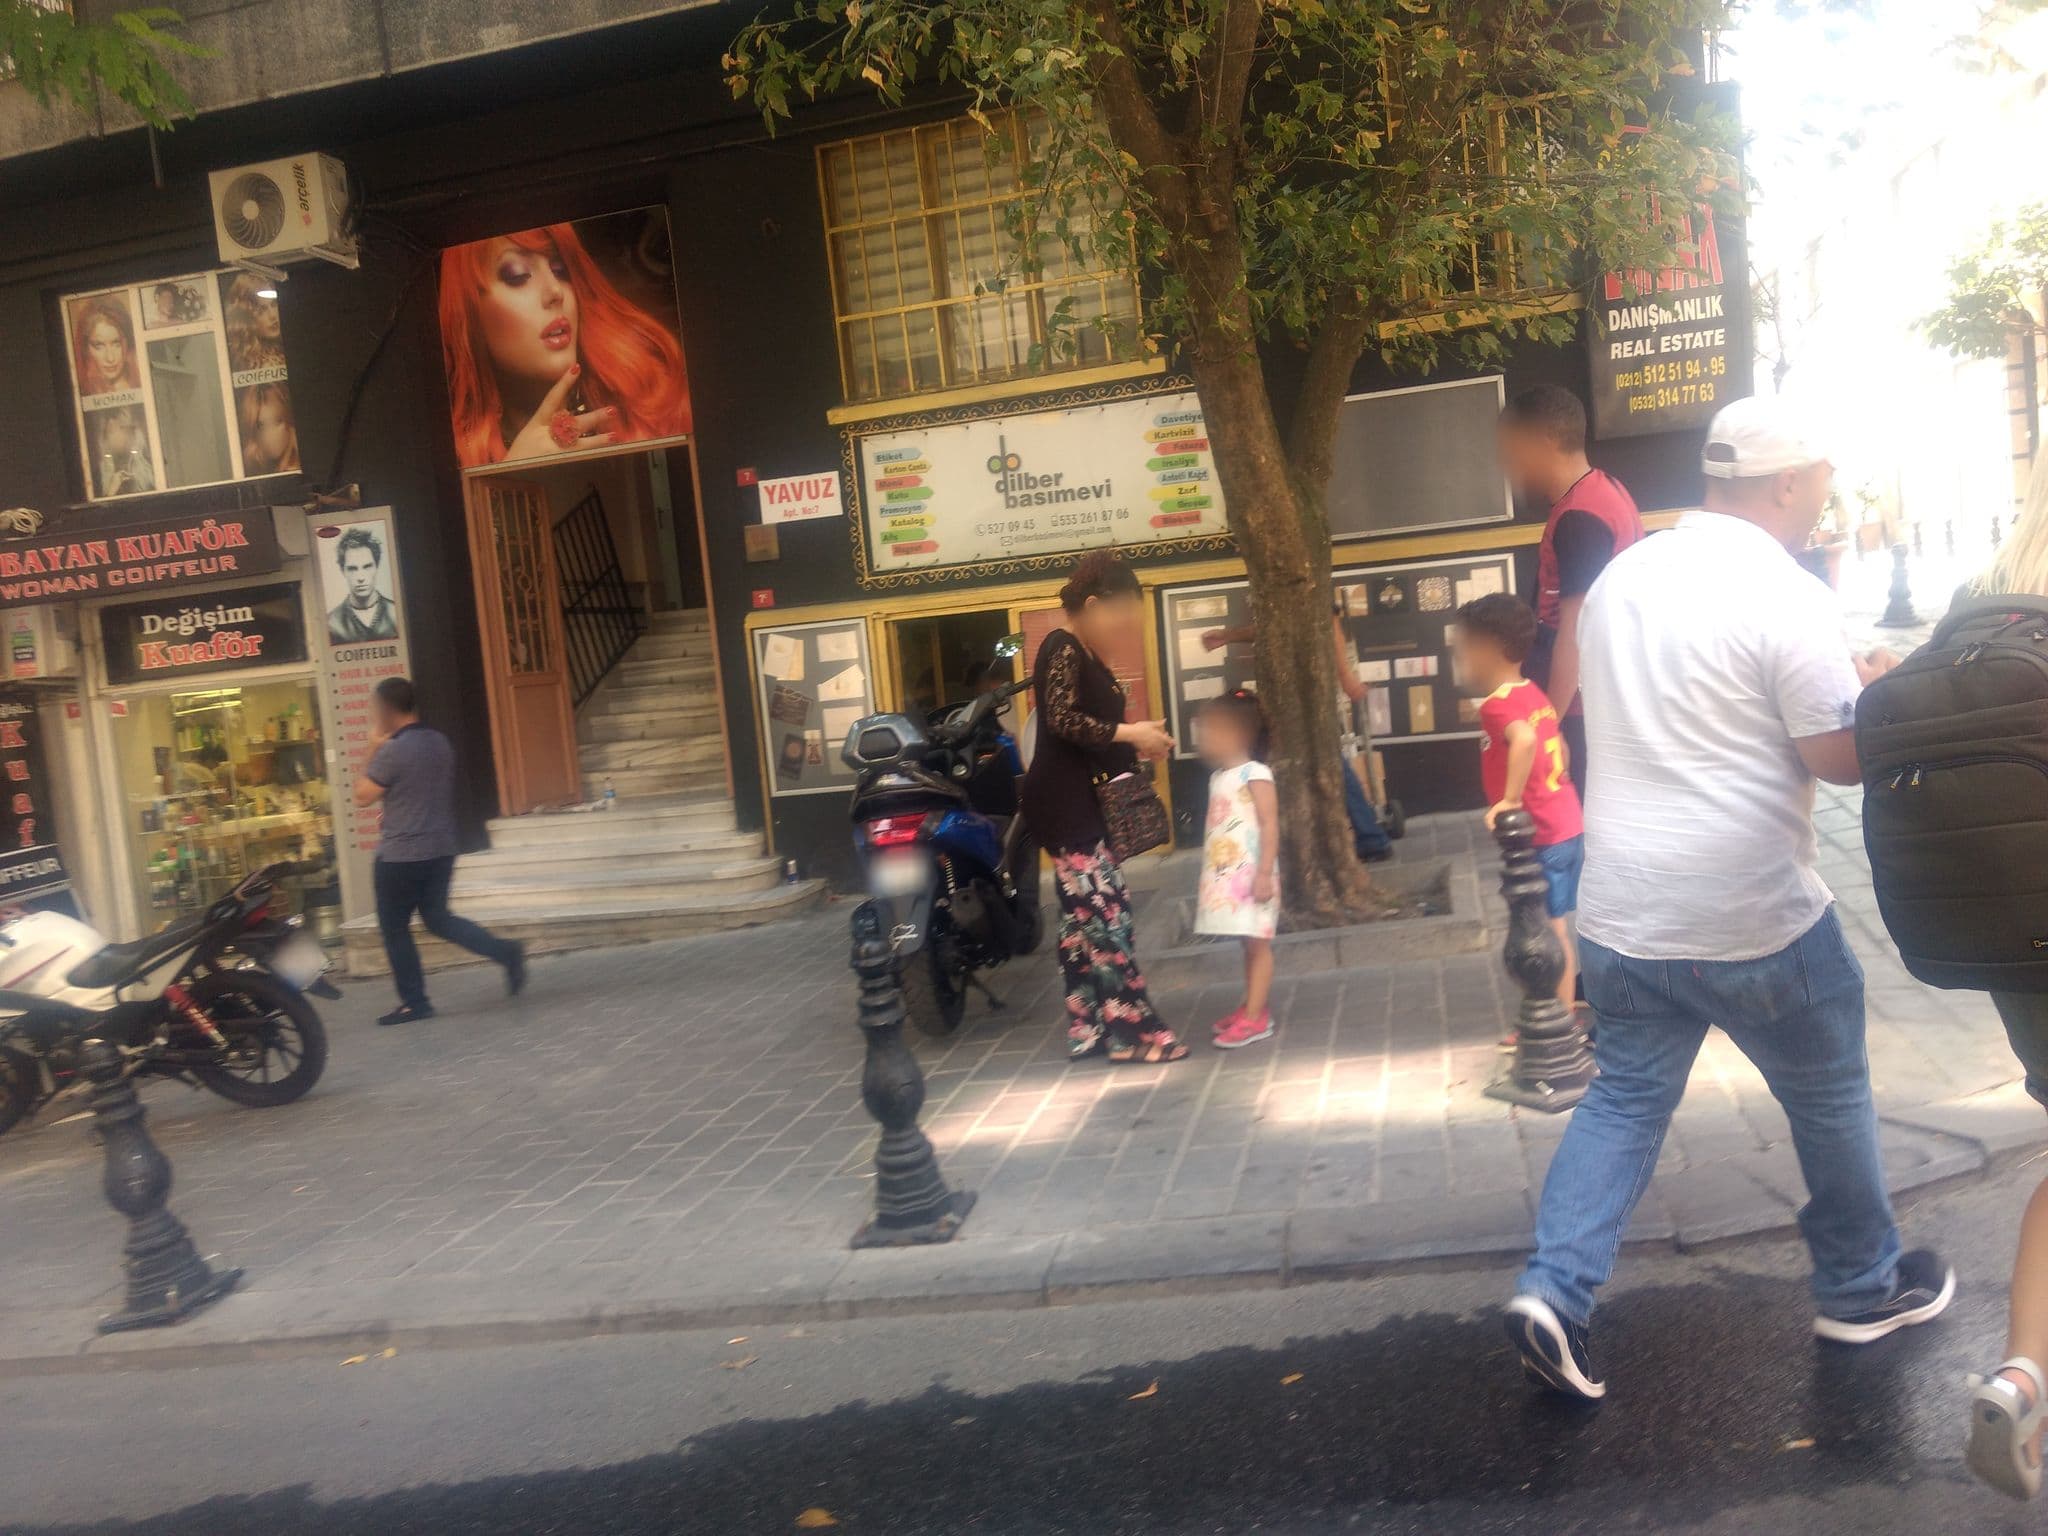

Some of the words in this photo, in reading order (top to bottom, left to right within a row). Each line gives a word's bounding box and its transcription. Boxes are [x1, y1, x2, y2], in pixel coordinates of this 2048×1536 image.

[293, 163, 310, 212] arçelik
[1610, 338, 1655, 360] REAL
[1660, 328, 1726, 353] ESTATE
[1644, 363, 1666, 384] 512
[1669, 361, 1682, 382] 51
[1686, 359, 1700, 379] 94
[1710, 356, 1726, 376] 95
[1657, 386, 1679, 408] 314
[1682, 384, 1697, 404] 77
[1699, 382, 1715, 402] 63
[1154, 428, 1195, 440] Kartvizit
[763, 477, 835, 505] YAVUZ
[995, 472, 1063, 494] dilber
[891, 517, 925, 527] Katalog
[0, 540, 111, 578] BAYAN
[116, 519, 250, 562] KUAFÖR
[0, 573, 99, 600] WOMAN
[106, 555, 239, 586] COIFFEUR
[141, 604, 255, 636] Değişim
[138, 631, 264, 669] Kuaför
[335, 646, 399, 662] COIFFEUR
